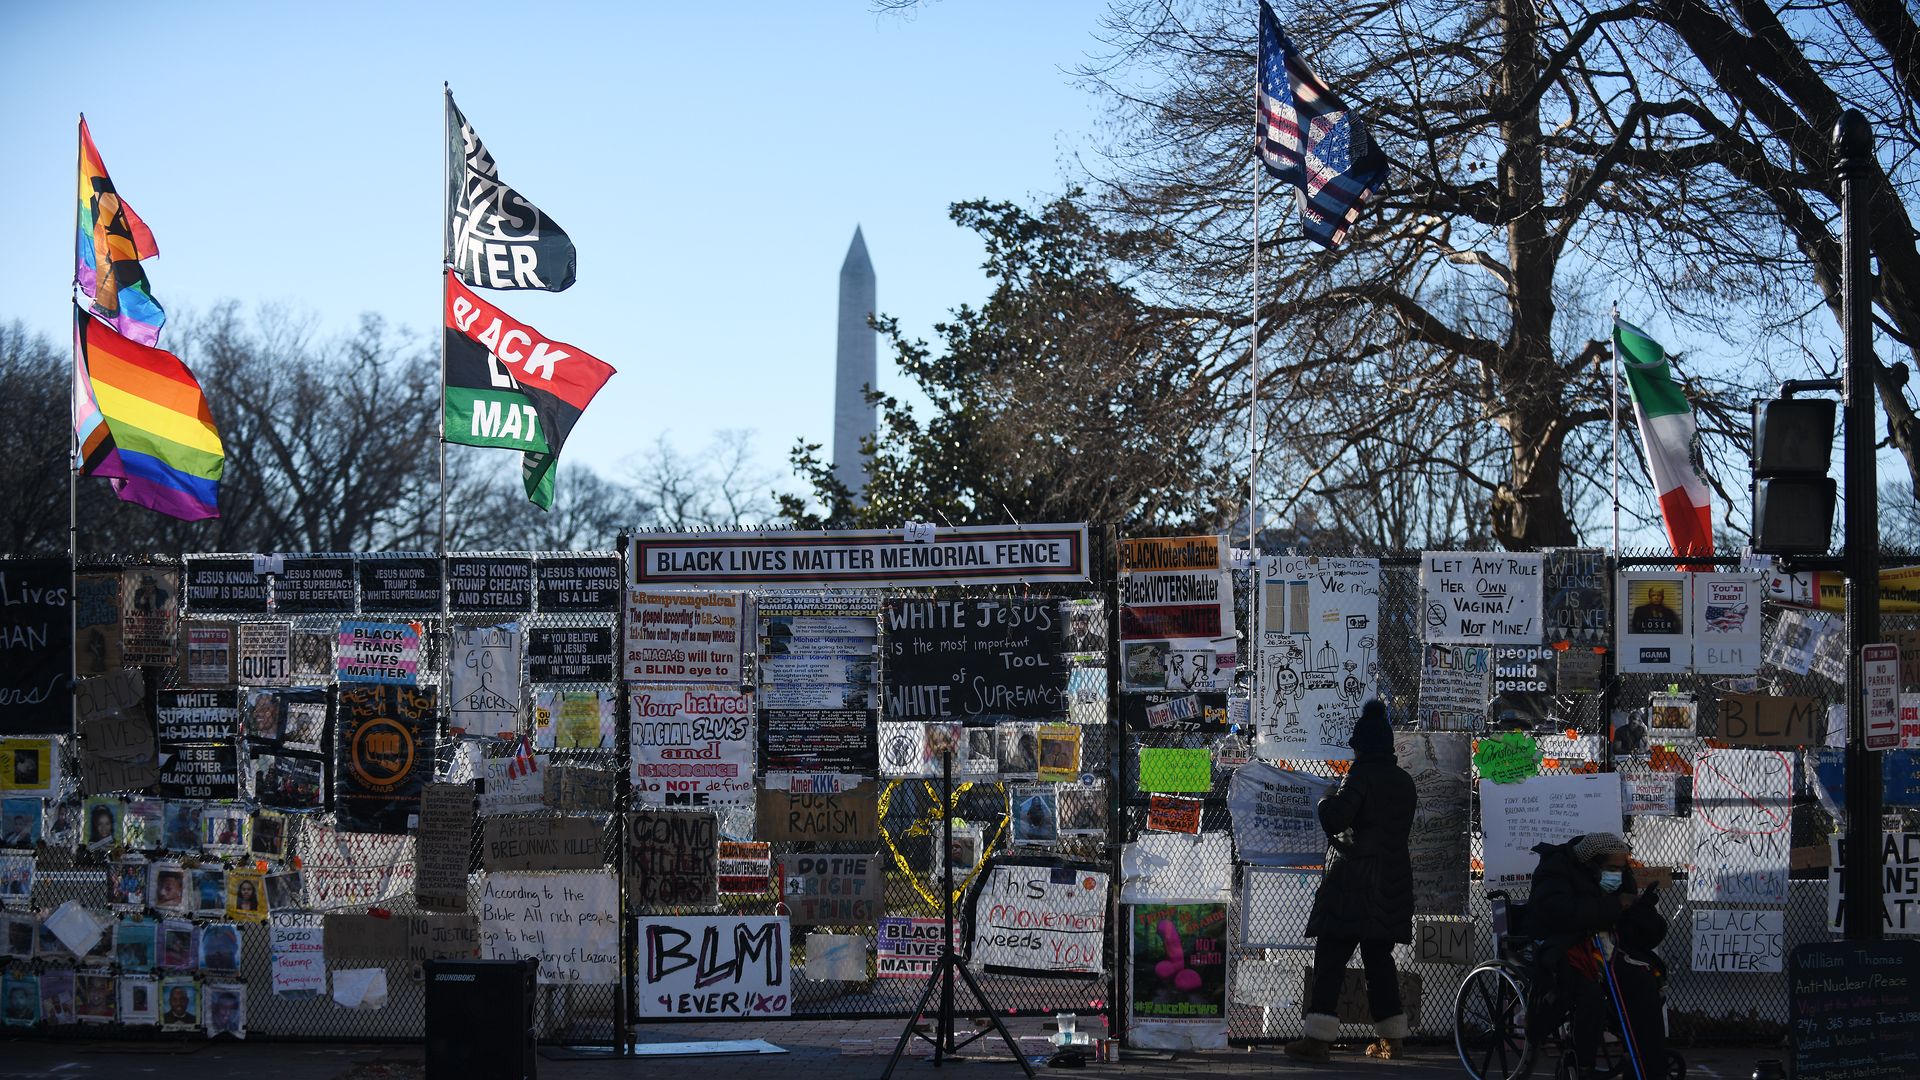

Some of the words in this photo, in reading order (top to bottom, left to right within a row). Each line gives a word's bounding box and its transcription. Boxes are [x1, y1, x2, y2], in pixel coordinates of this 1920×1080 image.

[909, 526, 929, 538] 42
[658, 551, 723, 572] BLACK
[730, 550, 786, 570] LIVES
[794, 548, 873, 570] MATTER
[881, 546, 990, 568] MEMORIAL
[997, 543, 1060, 563] FENCE
[1549, 552, 1603, 574] WHITE
[452, 564, 486, 577] JESUS
[490, 565, 528, 578] KNOWS
[540, 567, 574, 578] JESUS
[578, 566, 616, 578] KNOWS
[1432, 558, 1462, 573] LET
[1509, 560, 1537, 575] RULE
[196, 571, 224, 583] JESUS
[226, 571, 258, 583] KNOWS
[285, 570, 311, 579] JESUS
[313, 570, 342, 578] KNOWS
[275, 580, 301, 589] WHITE
[303, 580, 353, 589] SUPREMACY
[451, 578, 487, 590] TRUMP
[490, 579, 530, 591] CHEATS
[539, 580, 546, 590] A
[548, 580, 582, 590] WHITE
[585, 580, 619, 590] JESUS
[1441, 580, 1465, 593] HER
[1476, 578, 1506, 593] OWN
[1547, 575, 1603, 589] SILENCE
[1712, 584, 1743, 592] YOU'RE
[189, 586, 218, 599] TRUMP
[222, 586, 230, 599] IS
[232, 586, 266, 599] DEADLY
[300, 591, 310, 599] BE
[312, 591, 354, 600] DEFEATED
[458, 594, 480, 604] AND
[482, 593, 522, 605] STEALS
[559, 592, 570, 602] IS
[572, 592, 581, 602] A
[584, 592, 598, 602] LIE
[1566, 592, 1580, 607] IS
[1714, 592, 1741, 600] FIRED!
[1454, 596, 1513, 613] VAGINA!
[890, 602, 965, 630] WHITE
[1545, 610, 1604, 628] VIOLENCE
[1461, 620, 1486, 634] NOT
[1493, 618, 1531, 635] MINE!
[354, 629, 402, 641] BLACK
[542, 634, 549, 642] IF
[550, 634, 566, 642] YOU
[568, 634, 598, 642] BELIEVE
[353, 642, 402, 652] TRANS
[554, 644, 561, 653] IN
[564, 644, 587, 653] JESUS
[913, 637, 933, 653] the
[941, 636, 967, 652] most
[974, 637, 1029, 652] important
[356, 654, 398, 666] LIVES
[530, 656, 547, 664] HOW
[549, 655, 563, 664] CAN
[564, 655, 579, 664] YOU
[581, 654, 612, 664] BELIEVE
[629, 651, 641, 661] as
[688, 651, 708, 662] will
[711, 651, 733, 662] turn
[1425, 646, 1488, 673] BLACK
[1496, 647, 1553, 659] people
[1641, 651, 1668, 659] #GAMA
[1708, 649, 1742, 663] BLM
[242, 656, 289, 678] QUIET.
[466, 652, 493, 675] GO
[1000, 652, 1049, 669] TOOL
[348, 665, 406, 678] MATTER
[552, 666, 560, 675] IN
[562, 665, 590, 675] TRUMP?
[646, 665, 685, 675] BLIND
[690, 665, 711, 677] eye
[716, 665, 728, 675] to
[953, 668, 966, 683] of
[1496, 665, 1536, 678] build
[1877, 664, 1886, 674] NO
[1496, 681, 1547, 692] peace
[1868, 675, 1896, 686] PARKING
[177, 693, 217, 707] WHITE
[884, 686, 951, 716] WHITE
[965, 676, 1066, 715] SUPREMACY
[1872, 689, 1891, 698] EXCEPT
[470, 695, 506, 710] BACK!
[634, 695, 682, 716] Your
[685, 693, 748, 714] hatred
[159, 709, 237, 724] SUPREMACY
[1419, 710, 1485, 730] MATTERS
[1725, 700, 1818, 738] BLM
[166, 726, 178, 739] IS
[181, 725, 229, 739] DEADLY
[632, 722, 691, 746] RACIAL
[693, 717, 749, 741] SLURS
[179, 750, 193, 760] WE
[196, 750, 214, 760] SEE
[661, 741, 721, 759] and
[1236, 750, 1246, 758] DIE
[175, 763, 221, 773] ANOTHER
[162, 774, 196, 784] BLACK
[199, 774, 235, 784] WOMAN
[638, 779, 660, 792] do
[667, 781, 700, 791] NOT
[706, 778, 750, 792] define
[790, 776, 839, 793] AmeriKKKa
[185, 786, 211, 797] DEAD
[790, 794, 836, 809] FUCK
[789, 811, 856, 833] RACISM
[799, 859, 828, 875] DO
[832, 859, 867, 875] THE
[806, 878, 865, 895] RIGHT
[993, 867, 1045, 899] This
[485, 882, 540, 907] According
[544, 886, 553, 899] to
[564, 888, 584, 900] the
[484, 904, 515, 921] Bible
[524, 908, 542, 922] All
[551, 911, 572, 922] rich
[579, 911, 615, 925] people
[802, 900, 873, 919] THING!
[1696, 912, 1767, 931] BLACK
[411, 921, 428, 935] NO
[433, 928, 476, 942] JUSTICE
[484, 935, 498, 946] go
[506, 929, 516, 941] to
[522, 931, 544, 943] hell
[1423, 926, 1469, 960] BLM
[1700, 934, 1783, 957] ATHEISTS
[646, 923, 782, 989] BLM
[1798, 952, 1844, 968] William
[1854, 951, 1903, 964] Thomas
